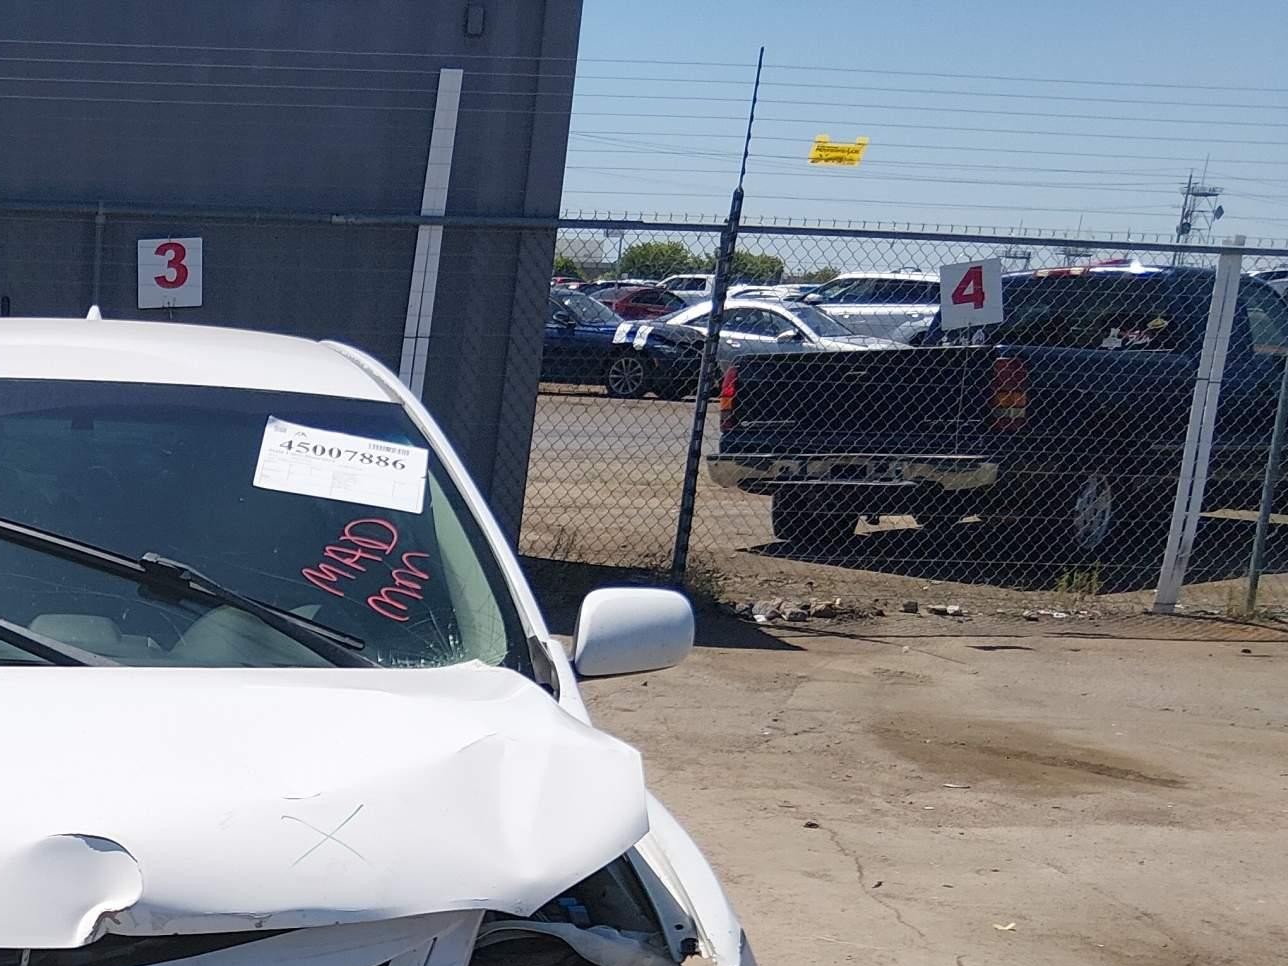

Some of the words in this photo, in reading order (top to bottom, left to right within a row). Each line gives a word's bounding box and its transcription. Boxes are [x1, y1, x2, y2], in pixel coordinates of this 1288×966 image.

[154, 242, 188, 289] 3
[952, 266, 985, 309] 4
[279, 439, 406, 470] 45007886
[302, 518, 398, 597] MAD
